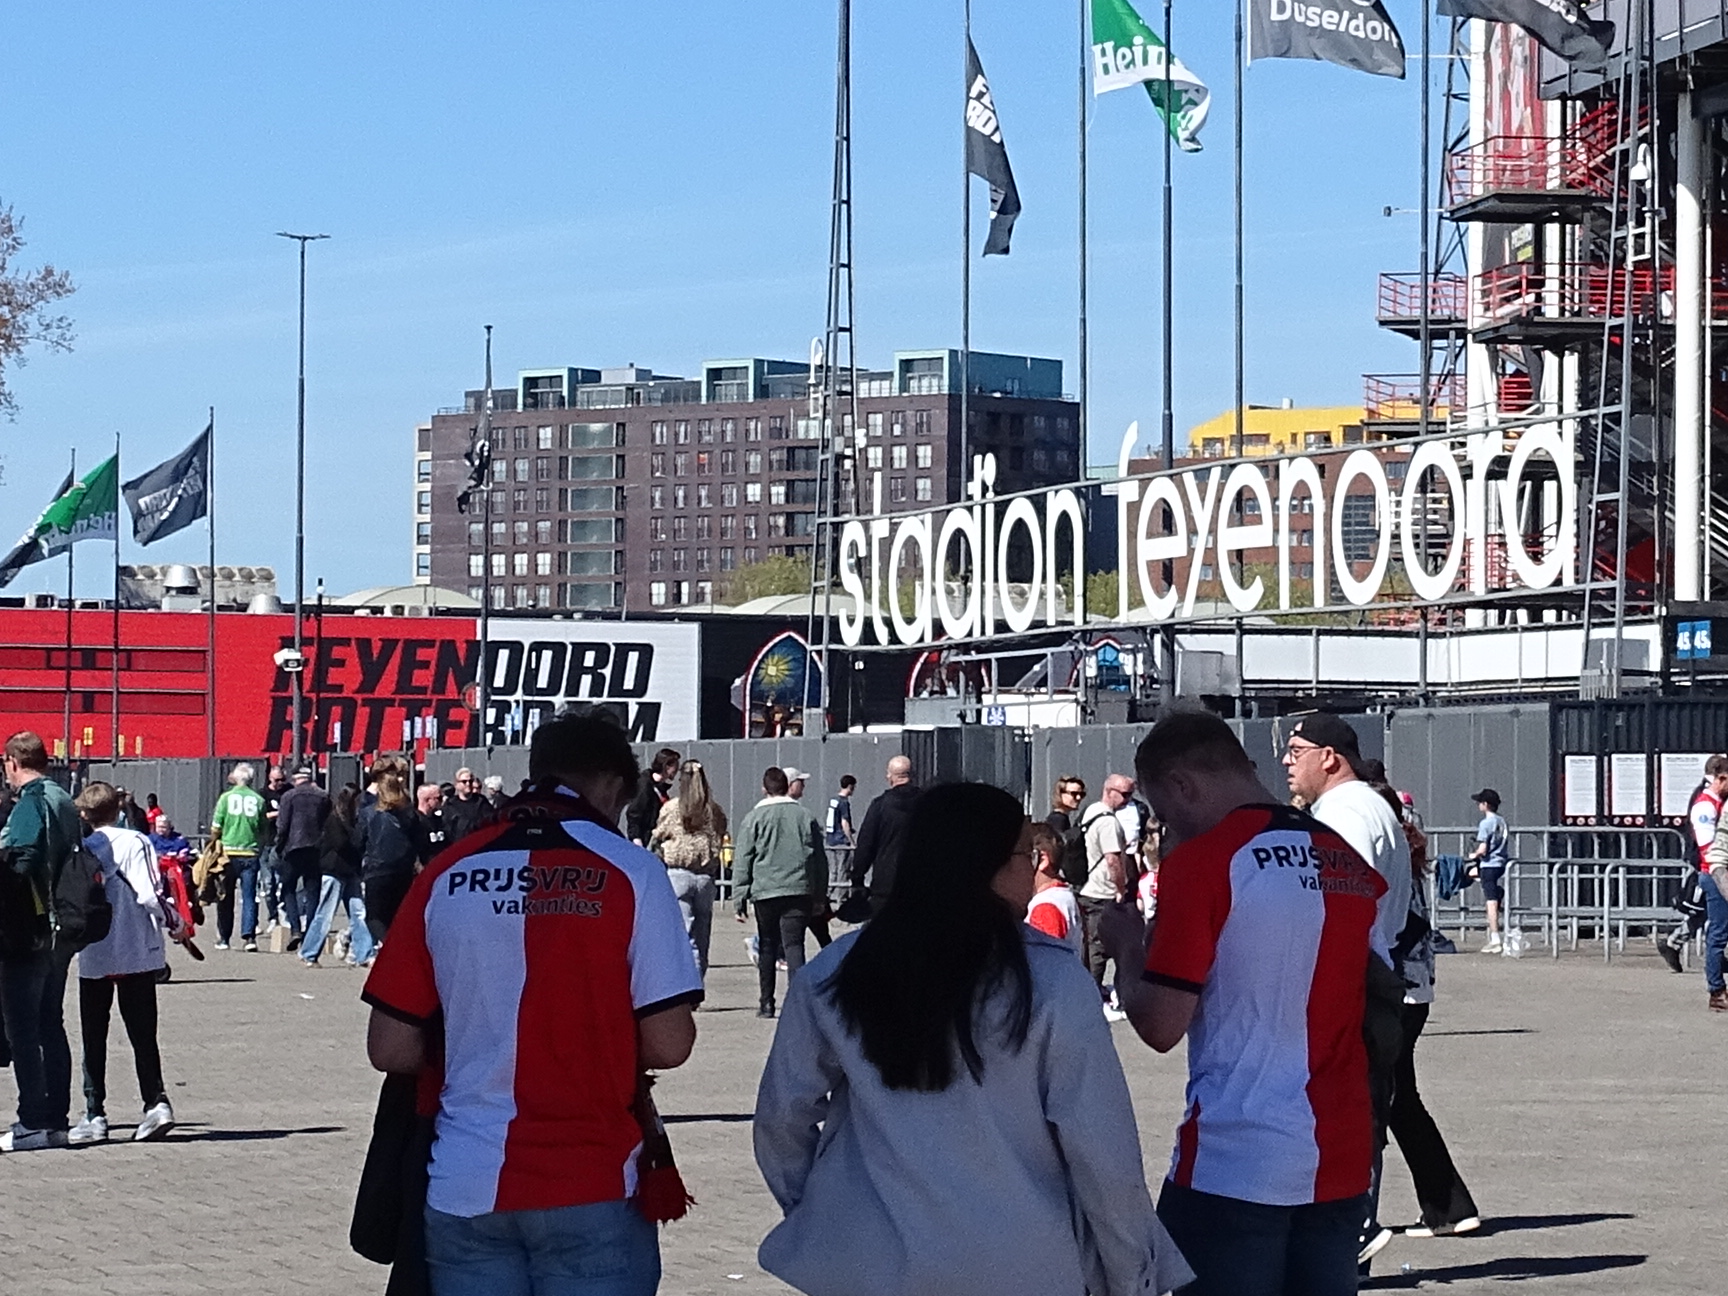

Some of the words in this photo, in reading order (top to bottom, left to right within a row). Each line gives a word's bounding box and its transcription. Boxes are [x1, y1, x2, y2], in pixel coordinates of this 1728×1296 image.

[839, 452, 1086, 647] stadion
[1118, 420, 1575, 623] feyenoord
[272, 636, 655, 699] FEYENOORD
[260, 698, 663, 754] ROTTERDM
[492, 894, 602, 917] vakanties
